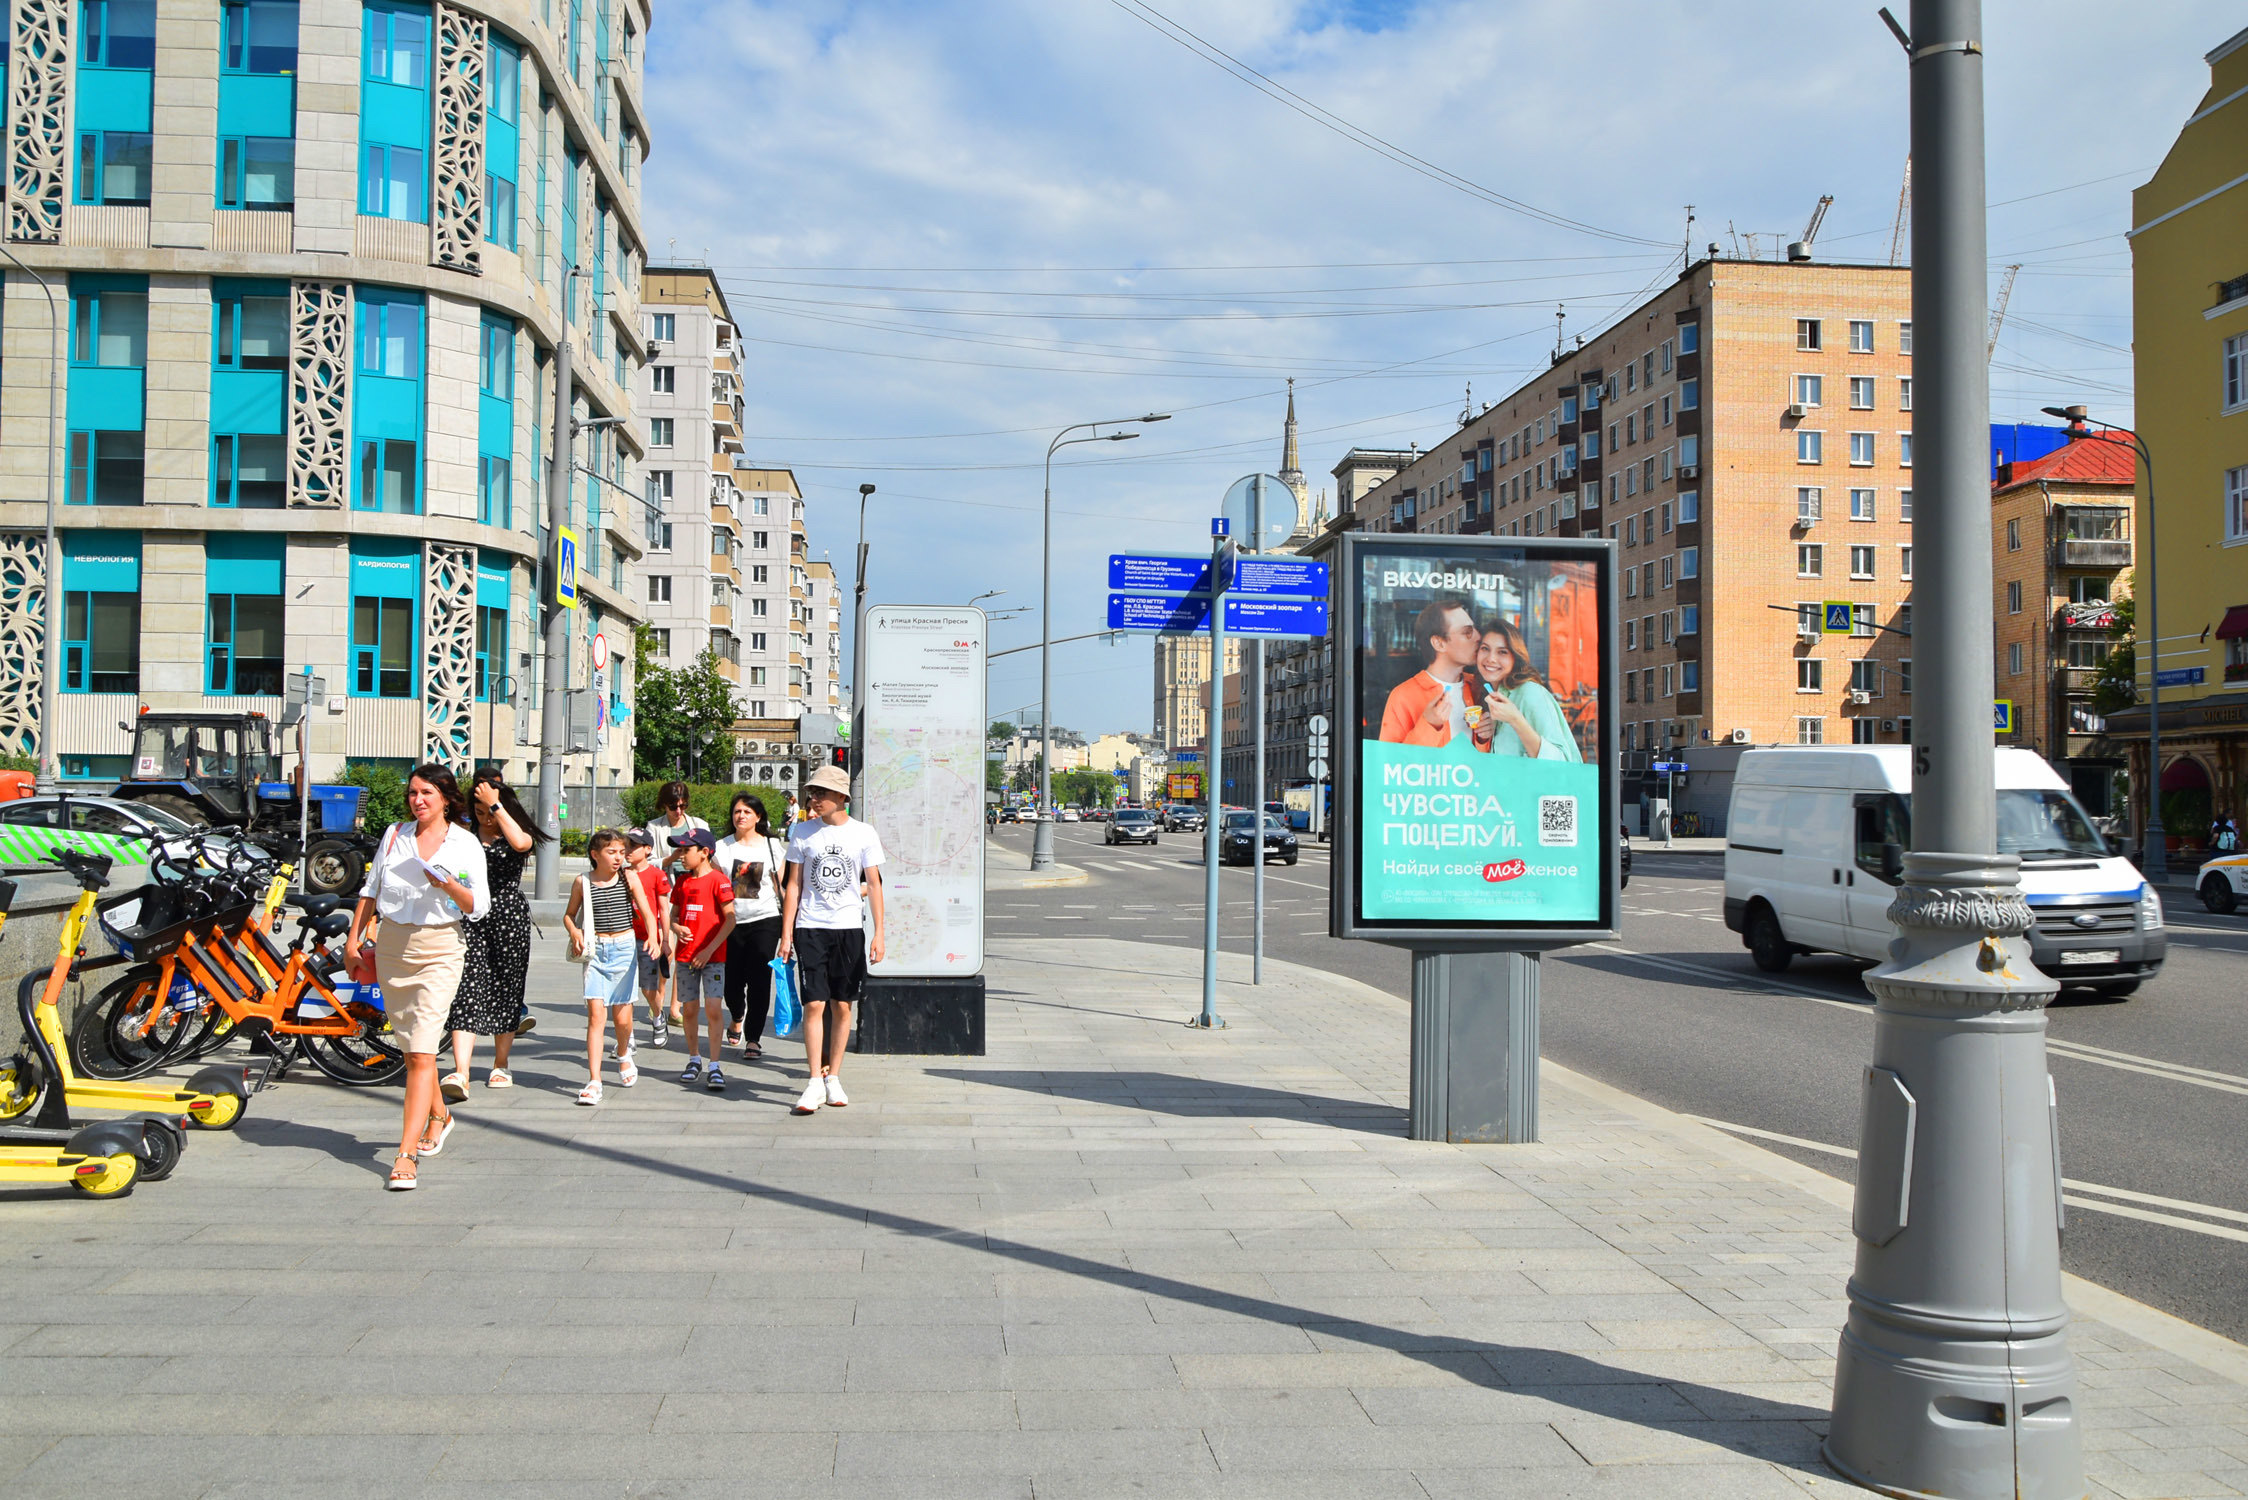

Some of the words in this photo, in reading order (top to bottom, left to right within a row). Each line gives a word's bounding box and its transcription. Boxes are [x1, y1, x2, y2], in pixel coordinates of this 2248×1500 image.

[1384, 571, 1504, 590] ВКУСВИЛЛ
[2202, 708, 2242, 721] MICHEL
[1383, 793, 1512, 817] ЧУВСТВА.
[1384, 820, 1522, 850] ПОЦЕЛУЙ.
[822, 867, 841, 877] DG
[1384, 860, 1439, 877] Найди
[1444, 861, 1483, 874] своё
